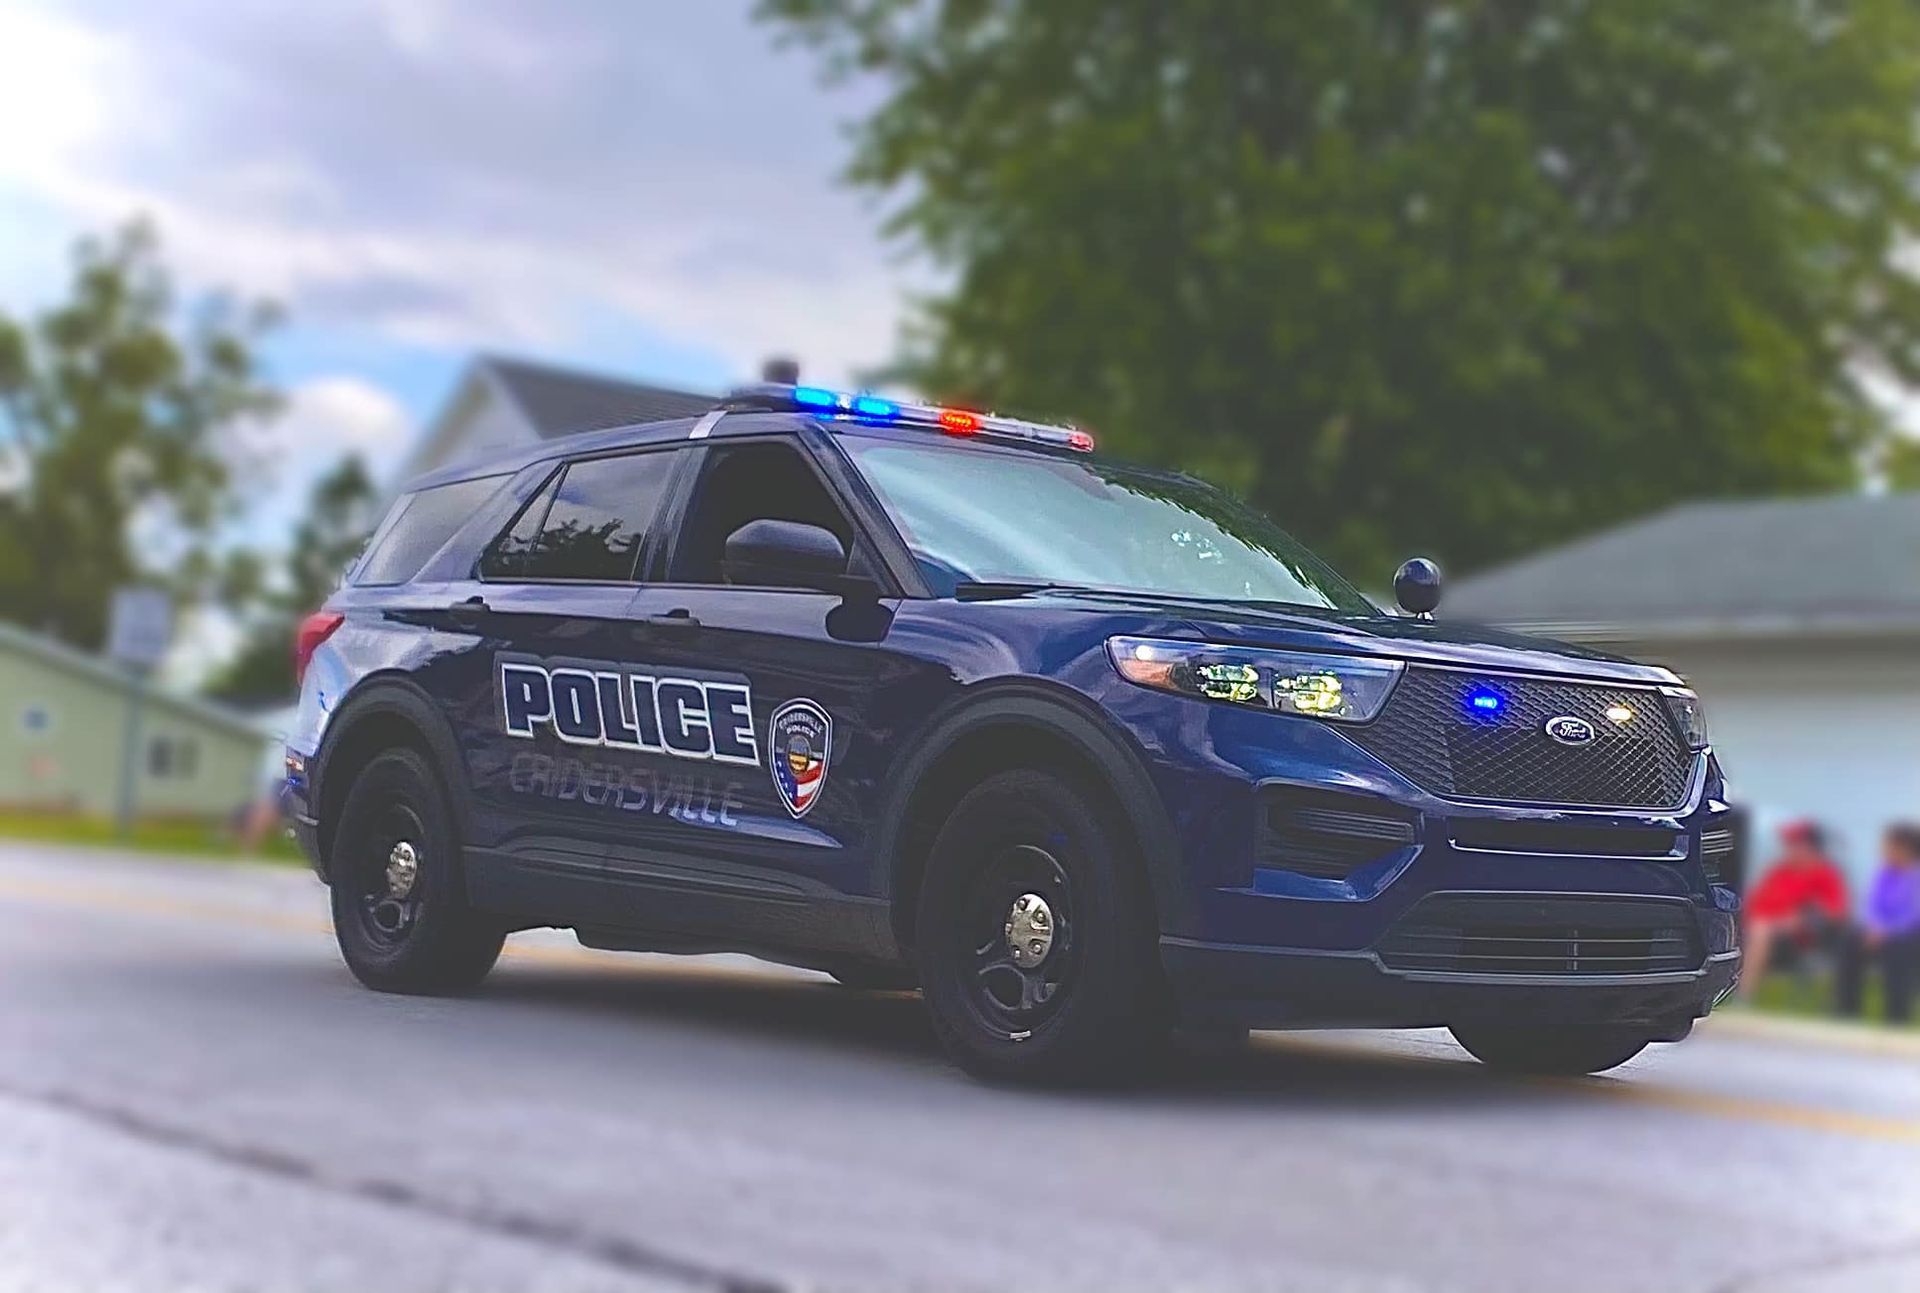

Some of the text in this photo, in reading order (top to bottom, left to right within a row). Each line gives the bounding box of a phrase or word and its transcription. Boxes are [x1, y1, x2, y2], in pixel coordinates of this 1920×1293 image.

[500, 662, 761, 767] POLICE
[786, 725, 816, 738] POLICE
[509, 752, 742, 827] CRIDERSVILLE
